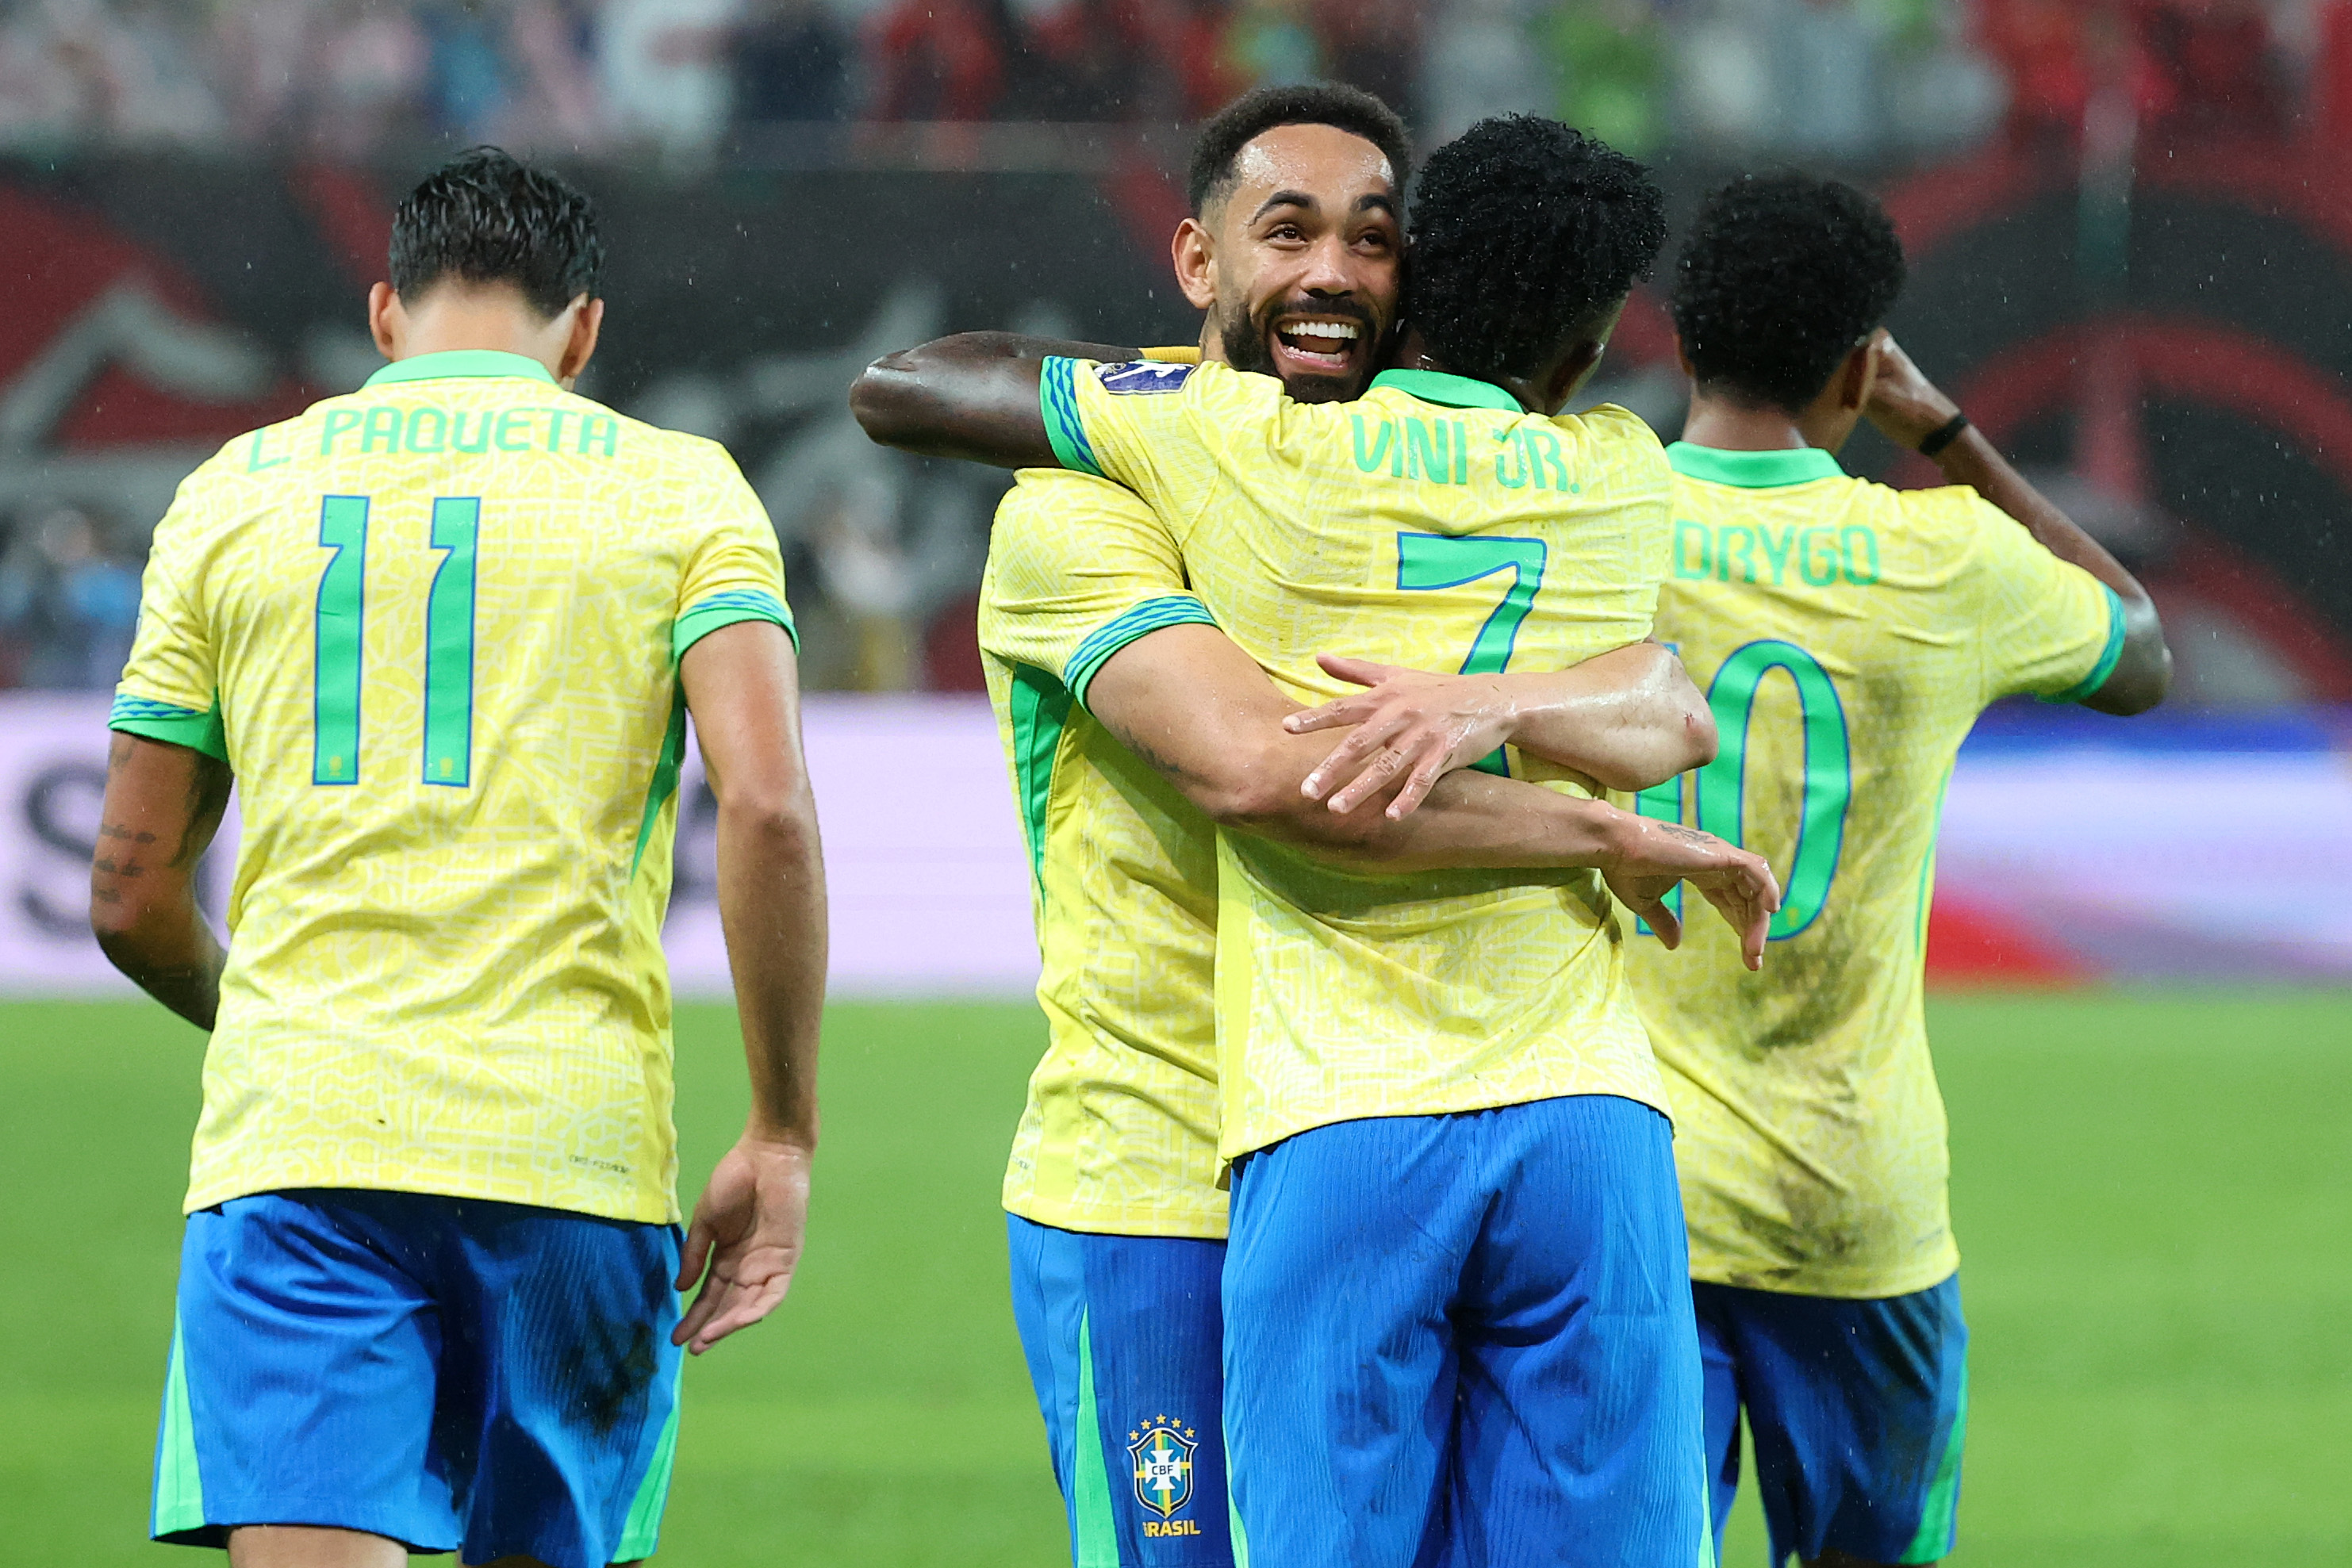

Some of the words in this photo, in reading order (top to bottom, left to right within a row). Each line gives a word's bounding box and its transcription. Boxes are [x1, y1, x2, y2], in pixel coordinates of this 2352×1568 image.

[320, 405, 618, 457] PAQUETA
[1351, 414, 1468, 485] VINI
[1492, 427, 1580, 494] JR.
[1673, 518, 1881, 587] DRYGO
[312, 494, 482, 788] 11
[1396, 531, 1548, 779] 7
[1151, 1464, 1174, 1476] CBF
